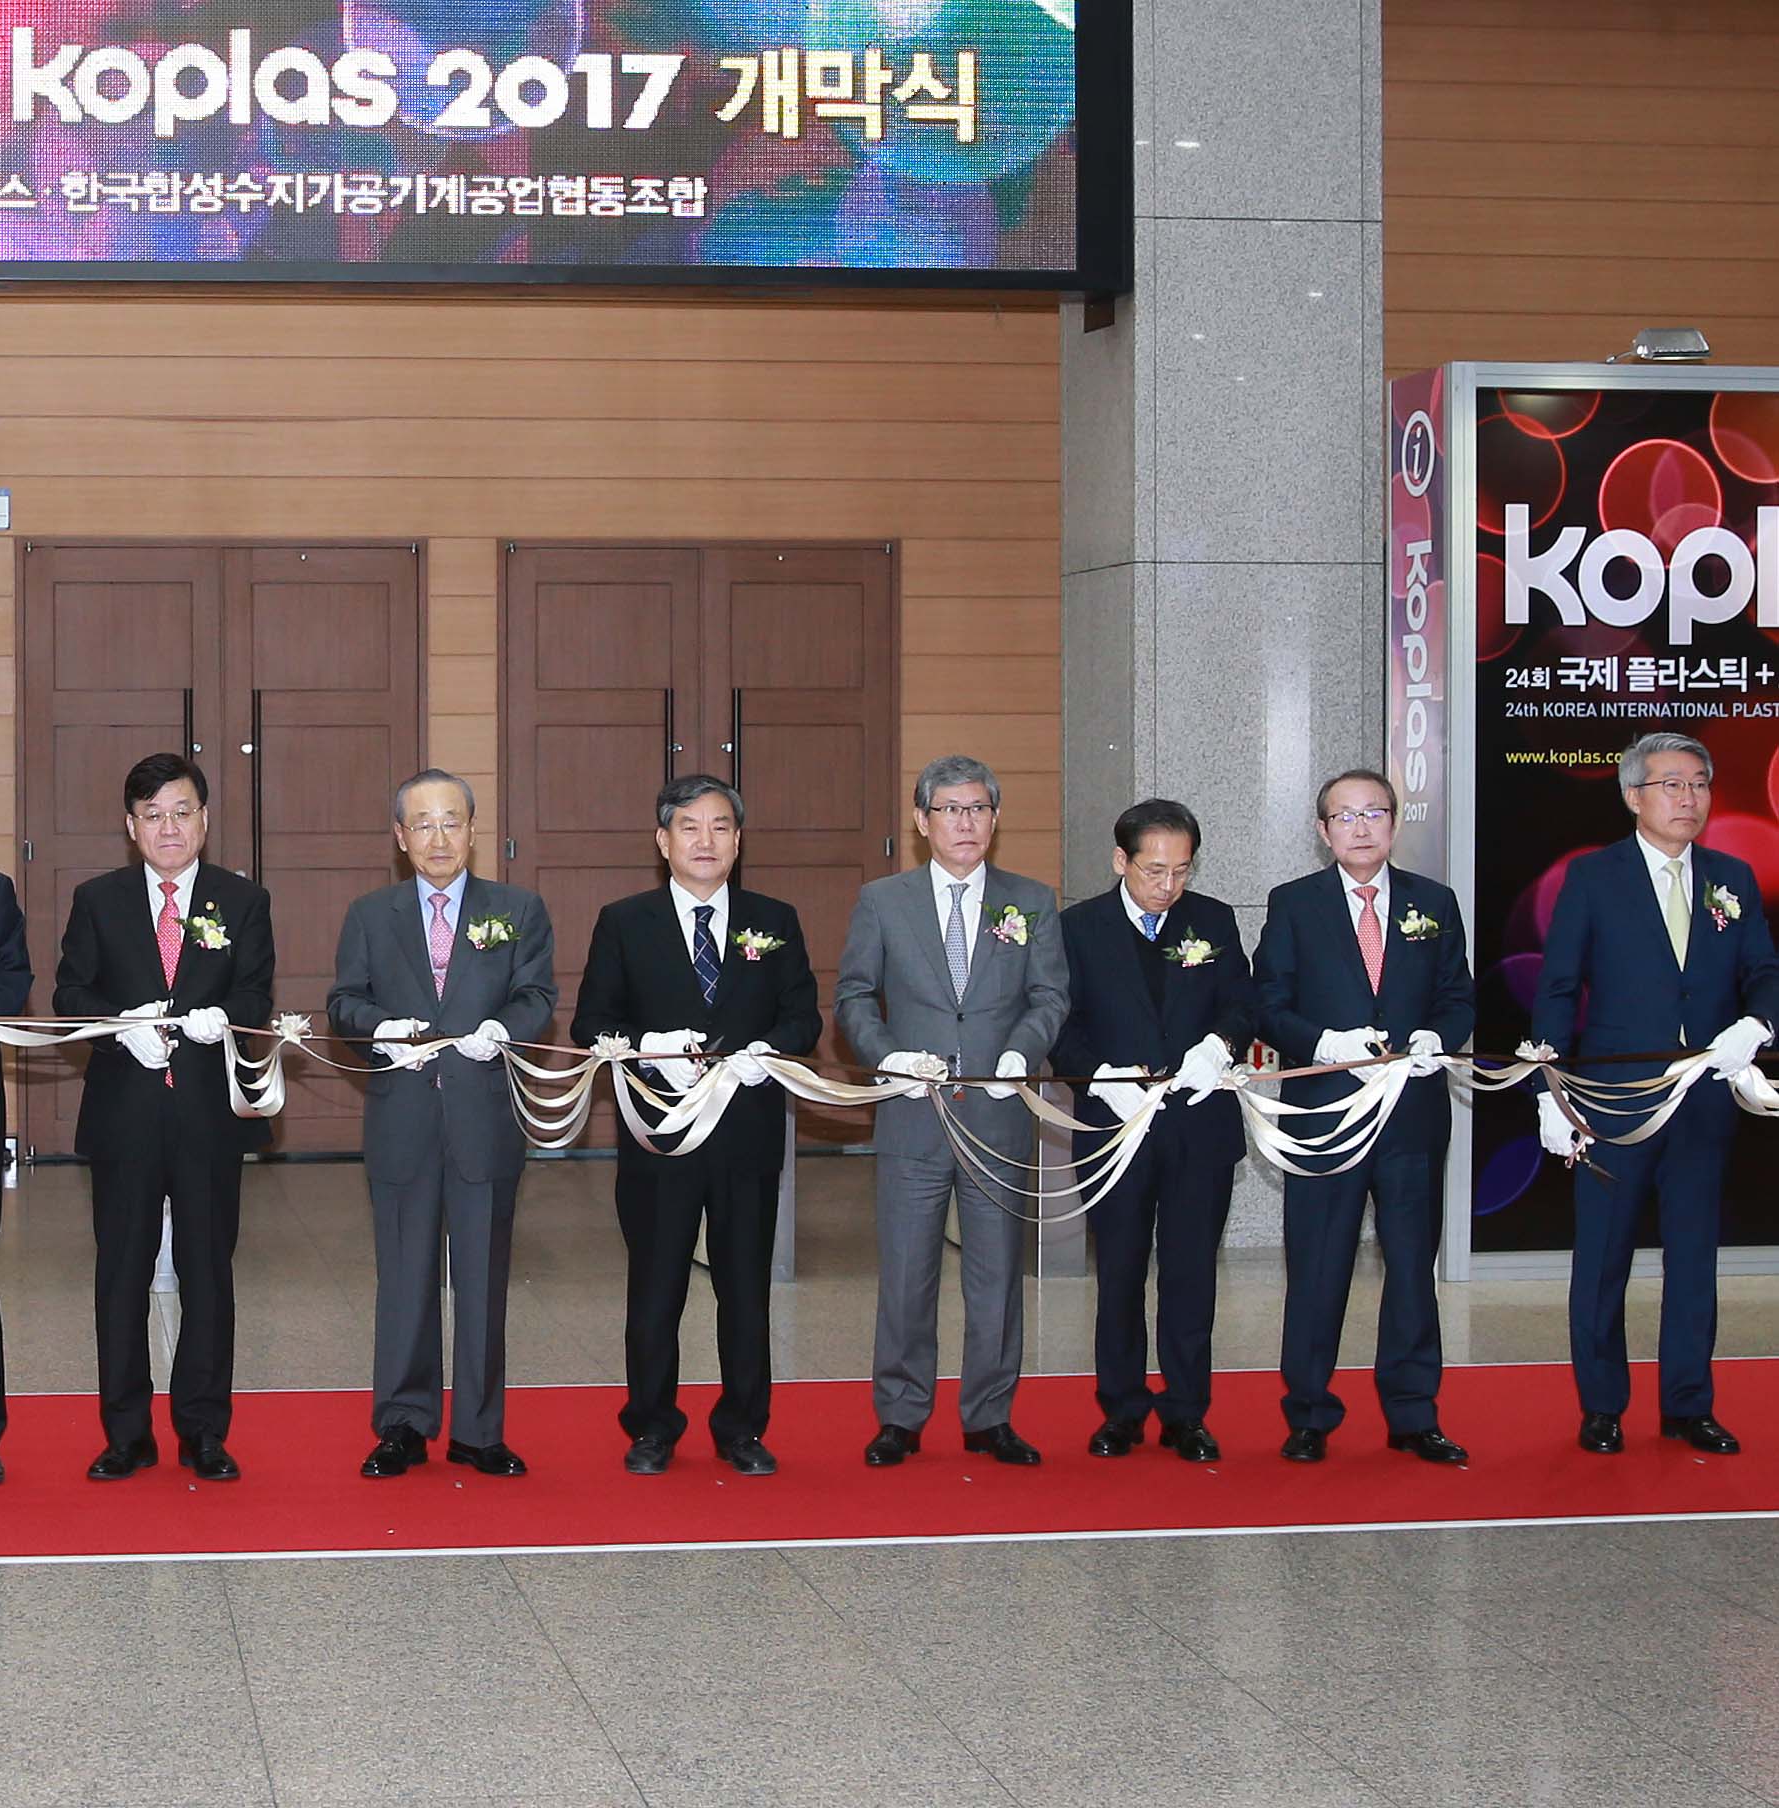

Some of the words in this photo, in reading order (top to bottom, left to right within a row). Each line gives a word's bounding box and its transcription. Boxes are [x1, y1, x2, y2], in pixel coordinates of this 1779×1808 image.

[12, 27, 398, 137] koplas
[426, 48, 687, 130] 2017
[715, 46, 979, 143] 개막식
[1504, 503, 1779, 645] kopl
[1402, 540, 1433, 793] koplas
[1505, 666, 1551, 690] 24회
[1557, 656, 1618, 692] 국제
[1625, 656, 1748, 692] 플라스틱
[1505, 702, 1539, 718] 24th
[1542, 702, 1598, 718] KOREA
[1600, 702, 1729, 718] INTERNATIONAL
[1404, 803, 1429, 822] 2017
